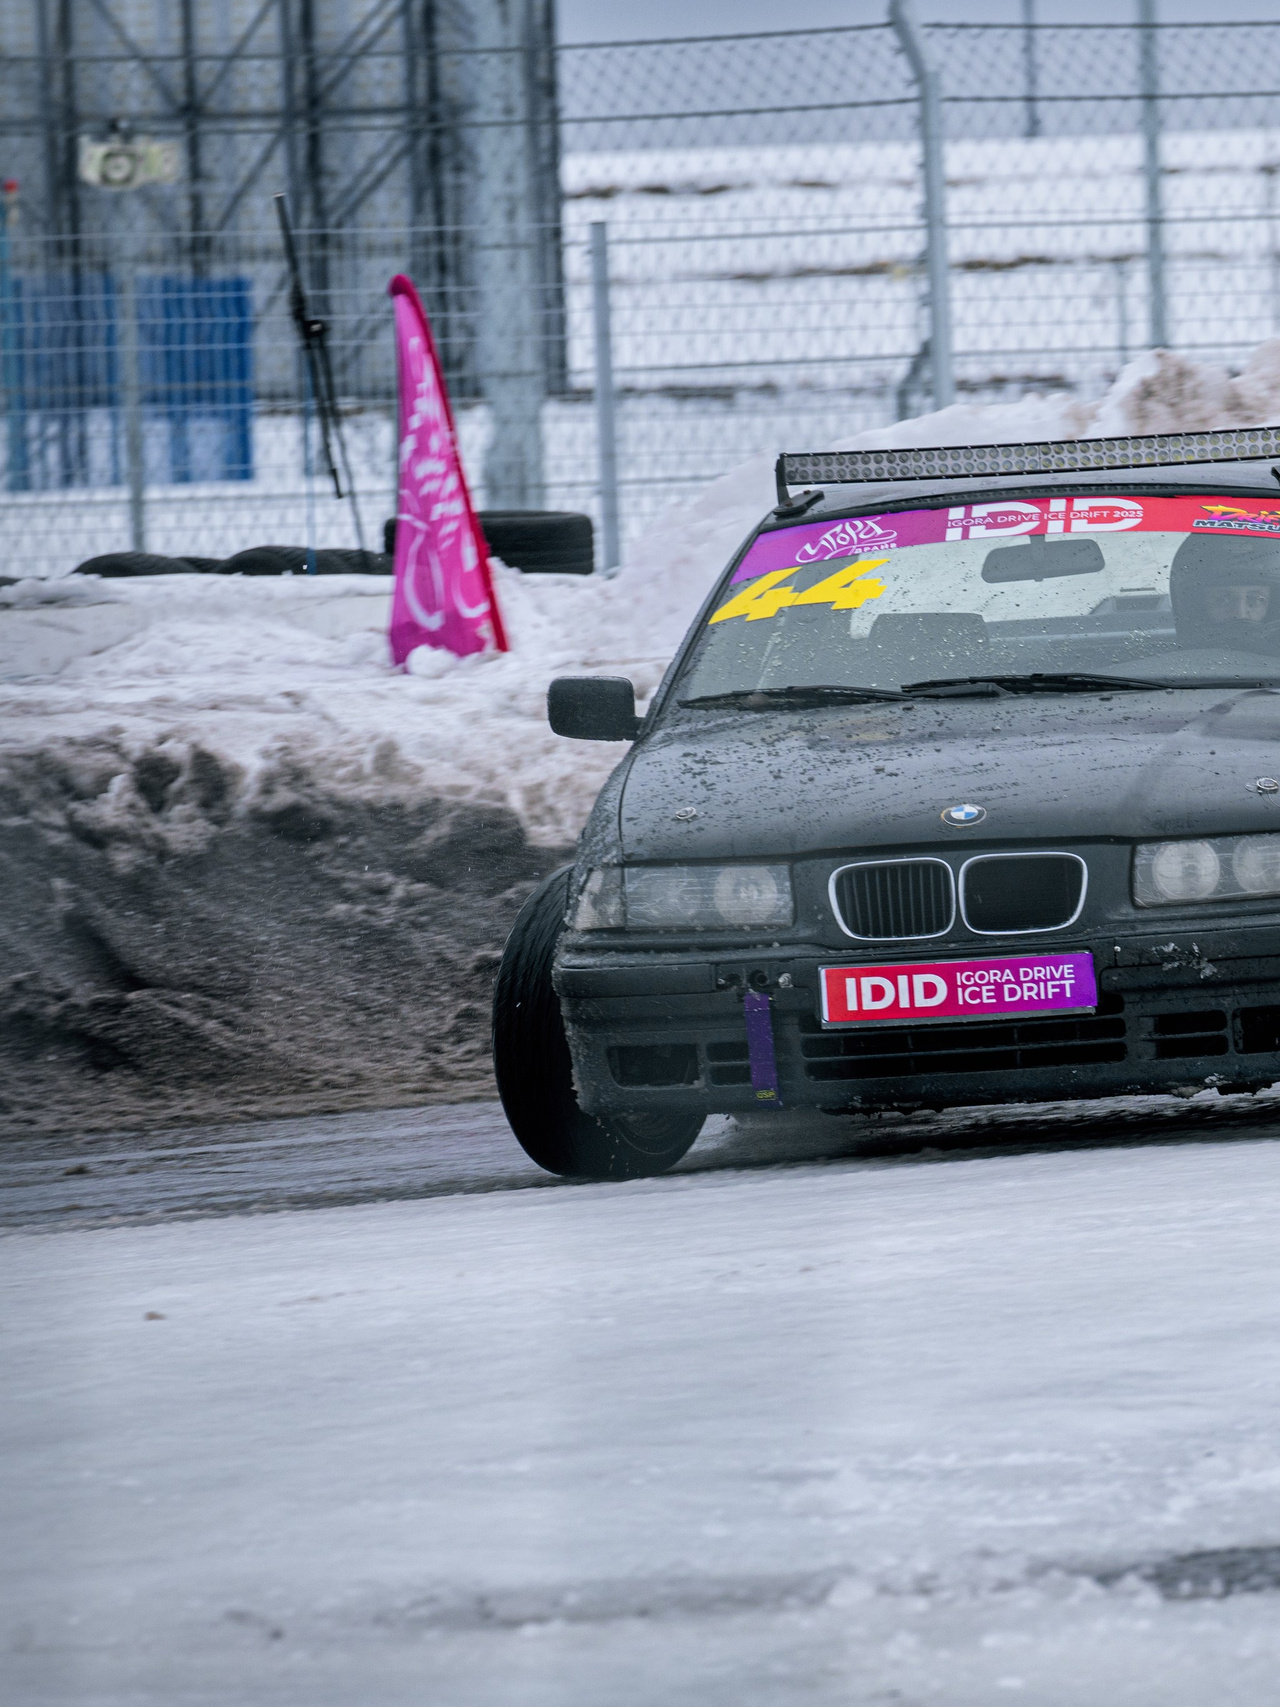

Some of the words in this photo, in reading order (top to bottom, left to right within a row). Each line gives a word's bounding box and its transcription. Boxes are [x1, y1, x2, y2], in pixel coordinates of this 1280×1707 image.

[947, 514, 994, 528] IGORA
[997, 512, 1040, 523] DRIVE
[1043, 511, 1066, 520] ICE
[1069, 510, 1110, 519] DRIFT
[1112, 509, 1144, 518] 2025
[707, 558, 890, 625] 44
[956, 968, 1015, 986] IGORA
[1018, 964, 1075, 982] DRIVE
[845, 973, 948, 1011] IDID
[957, 985, 996, 1005] ICE
[1003, 979, 1075, 1002] DRIFT
